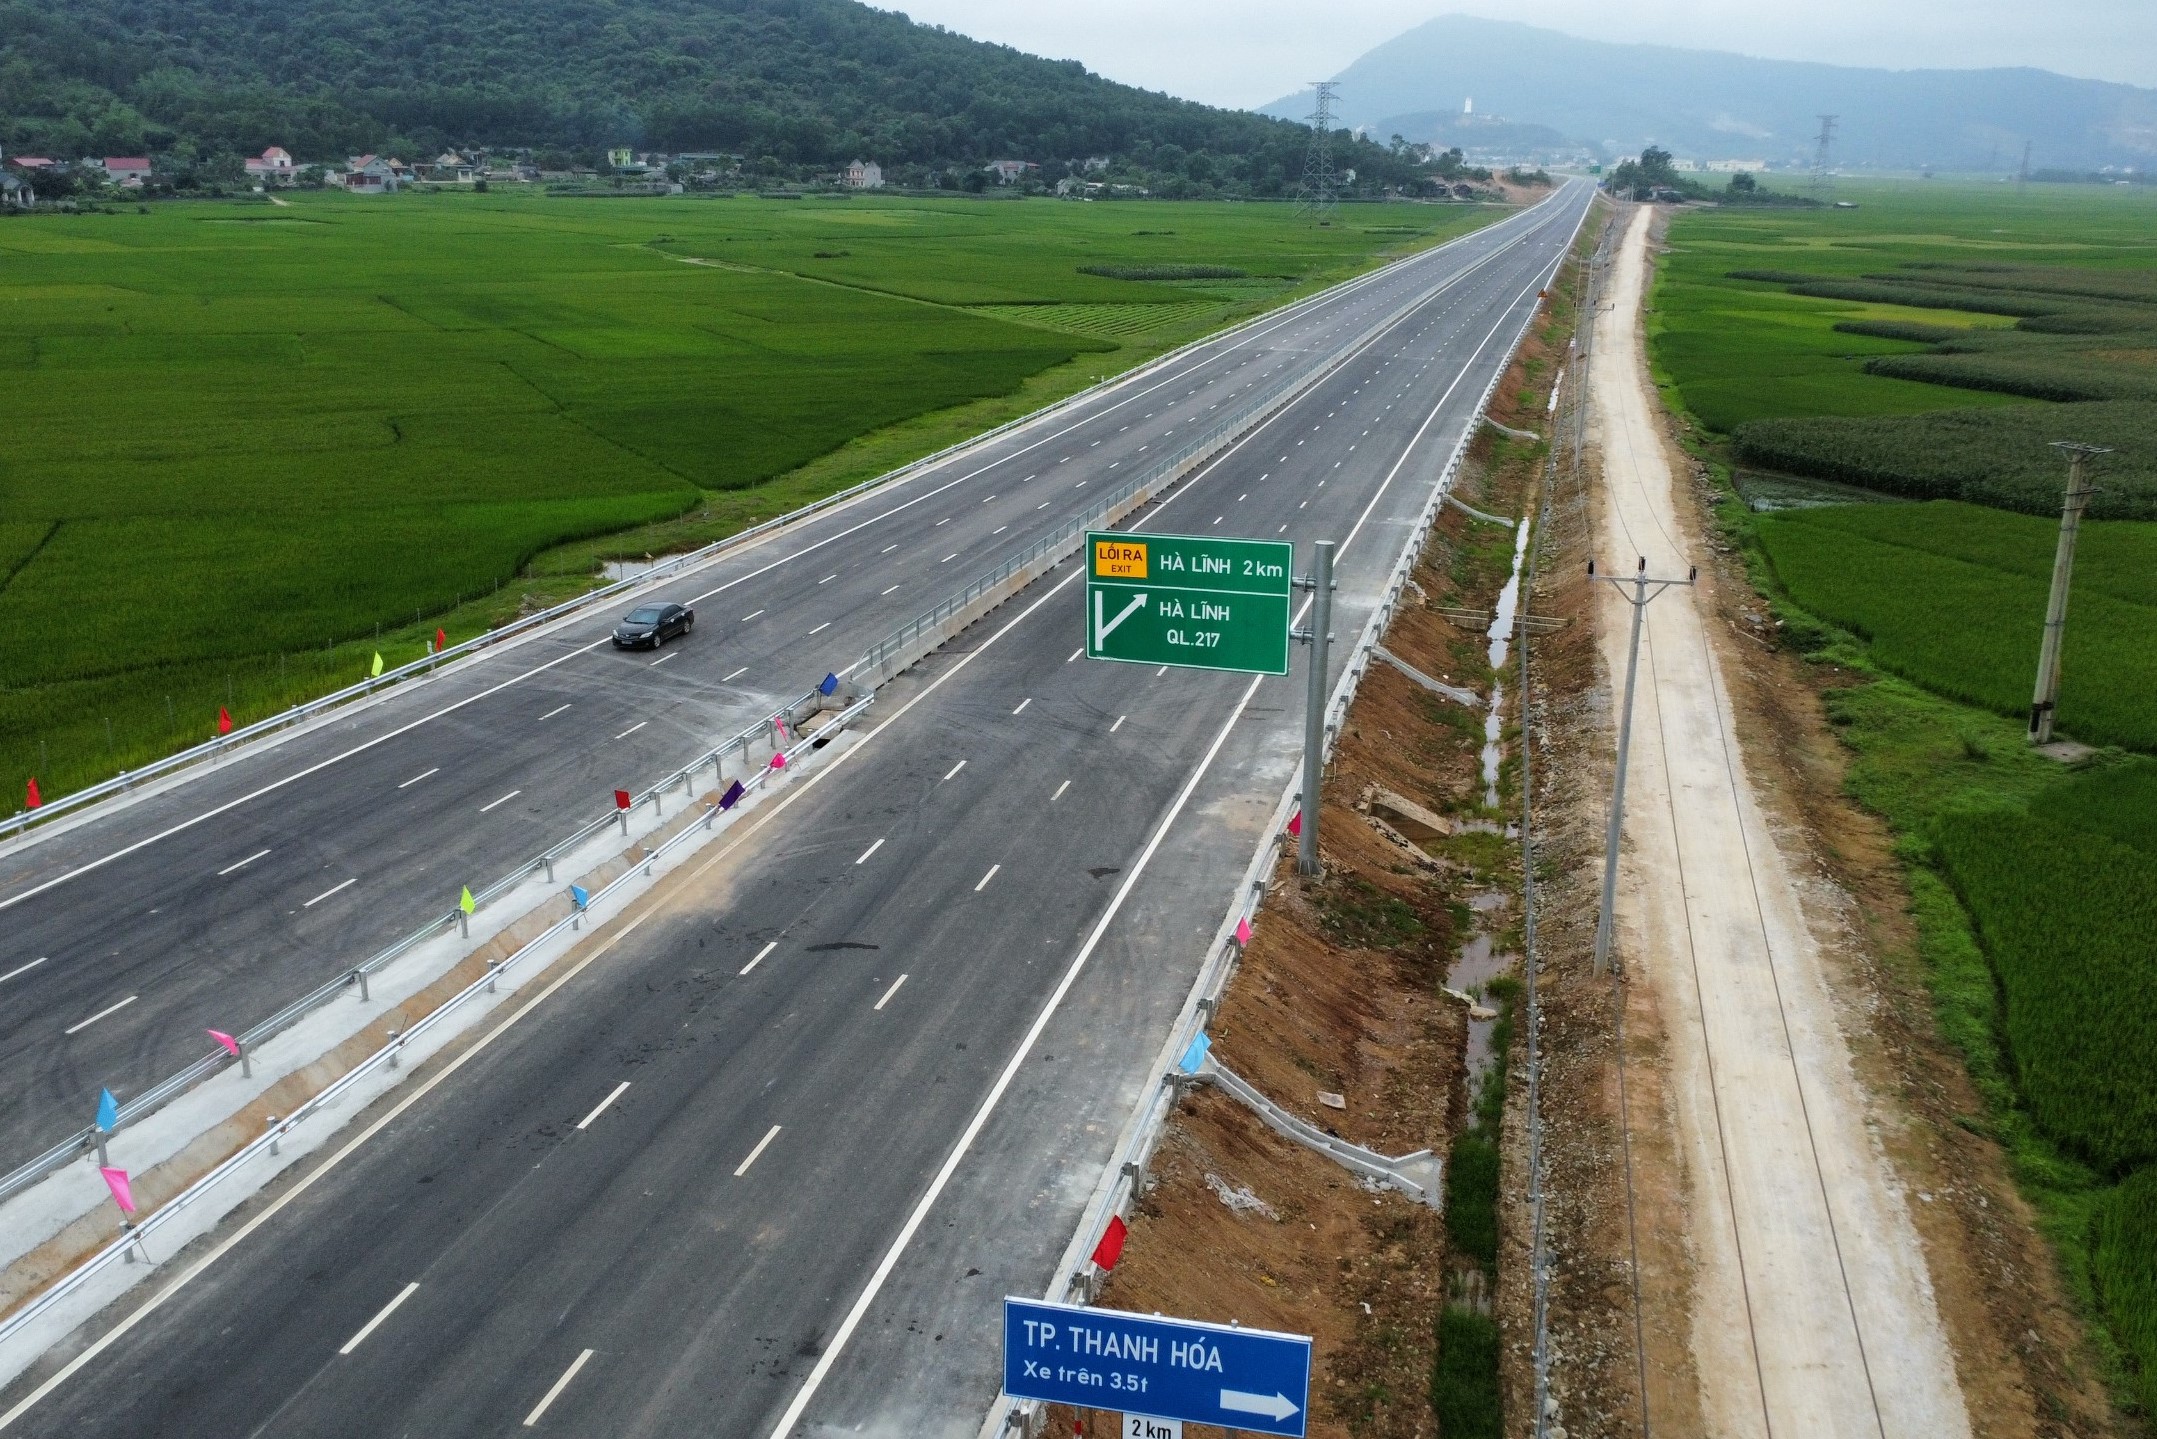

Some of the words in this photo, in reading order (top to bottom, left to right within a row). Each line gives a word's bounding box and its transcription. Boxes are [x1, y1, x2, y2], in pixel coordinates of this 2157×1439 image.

[1100, 543, 1119, 560] LỐI
[1124, 549, 1143, 561] RA
[1161, 552, 1184, 571] HÀ
[1191, 554, 1230, 574] LĨNH
[1160, 599, 1184, 618] HÀ
[1191, 601, 1229, 621] LĨNH
[1167, 629, 1220, 647] QL.217
[1023, 1320, 1060, 1350] TP.
[1069, 1326, 1158, 1363] THANH
[1171, 1337, 1223, 1373] HÓA
[1023, 1360, 1051, 1379] Xe
[1059, 1367, 1103, 1386] trên
[1110, 1372, 1148, 1393] 3.5t
